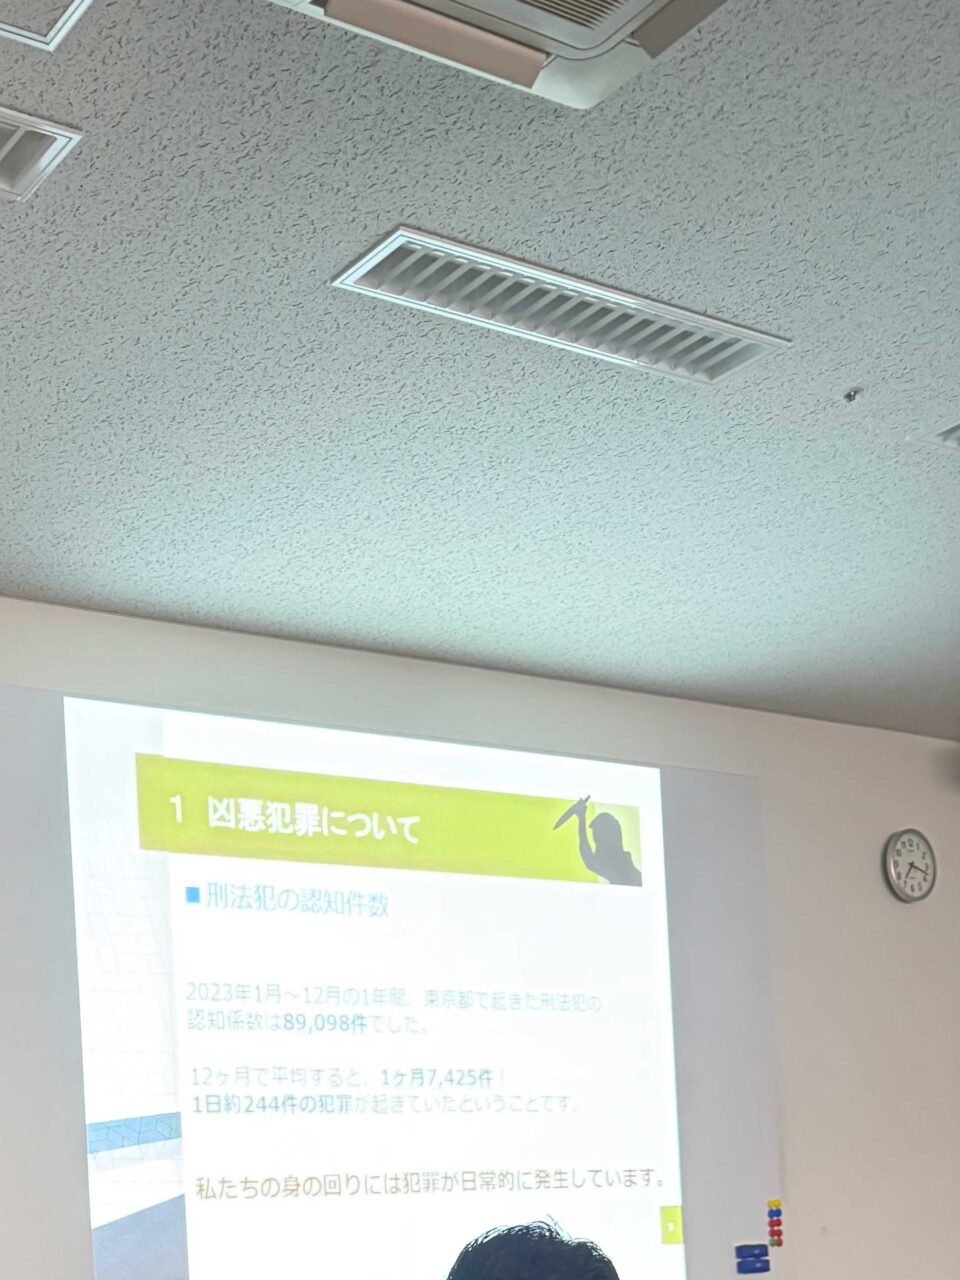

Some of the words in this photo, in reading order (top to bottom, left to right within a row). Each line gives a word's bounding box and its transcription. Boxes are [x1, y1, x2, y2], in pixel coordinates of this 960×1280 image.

[169, 794, 183, 824] 1
[207, 795, 421, 844] 凶悪犯罪について
[205, 881, 390, 918] 刑法犯の認知件数
[196, 1166, 665, 1200] 私たちの身の回りには犯罪が日常的に発生しています。
